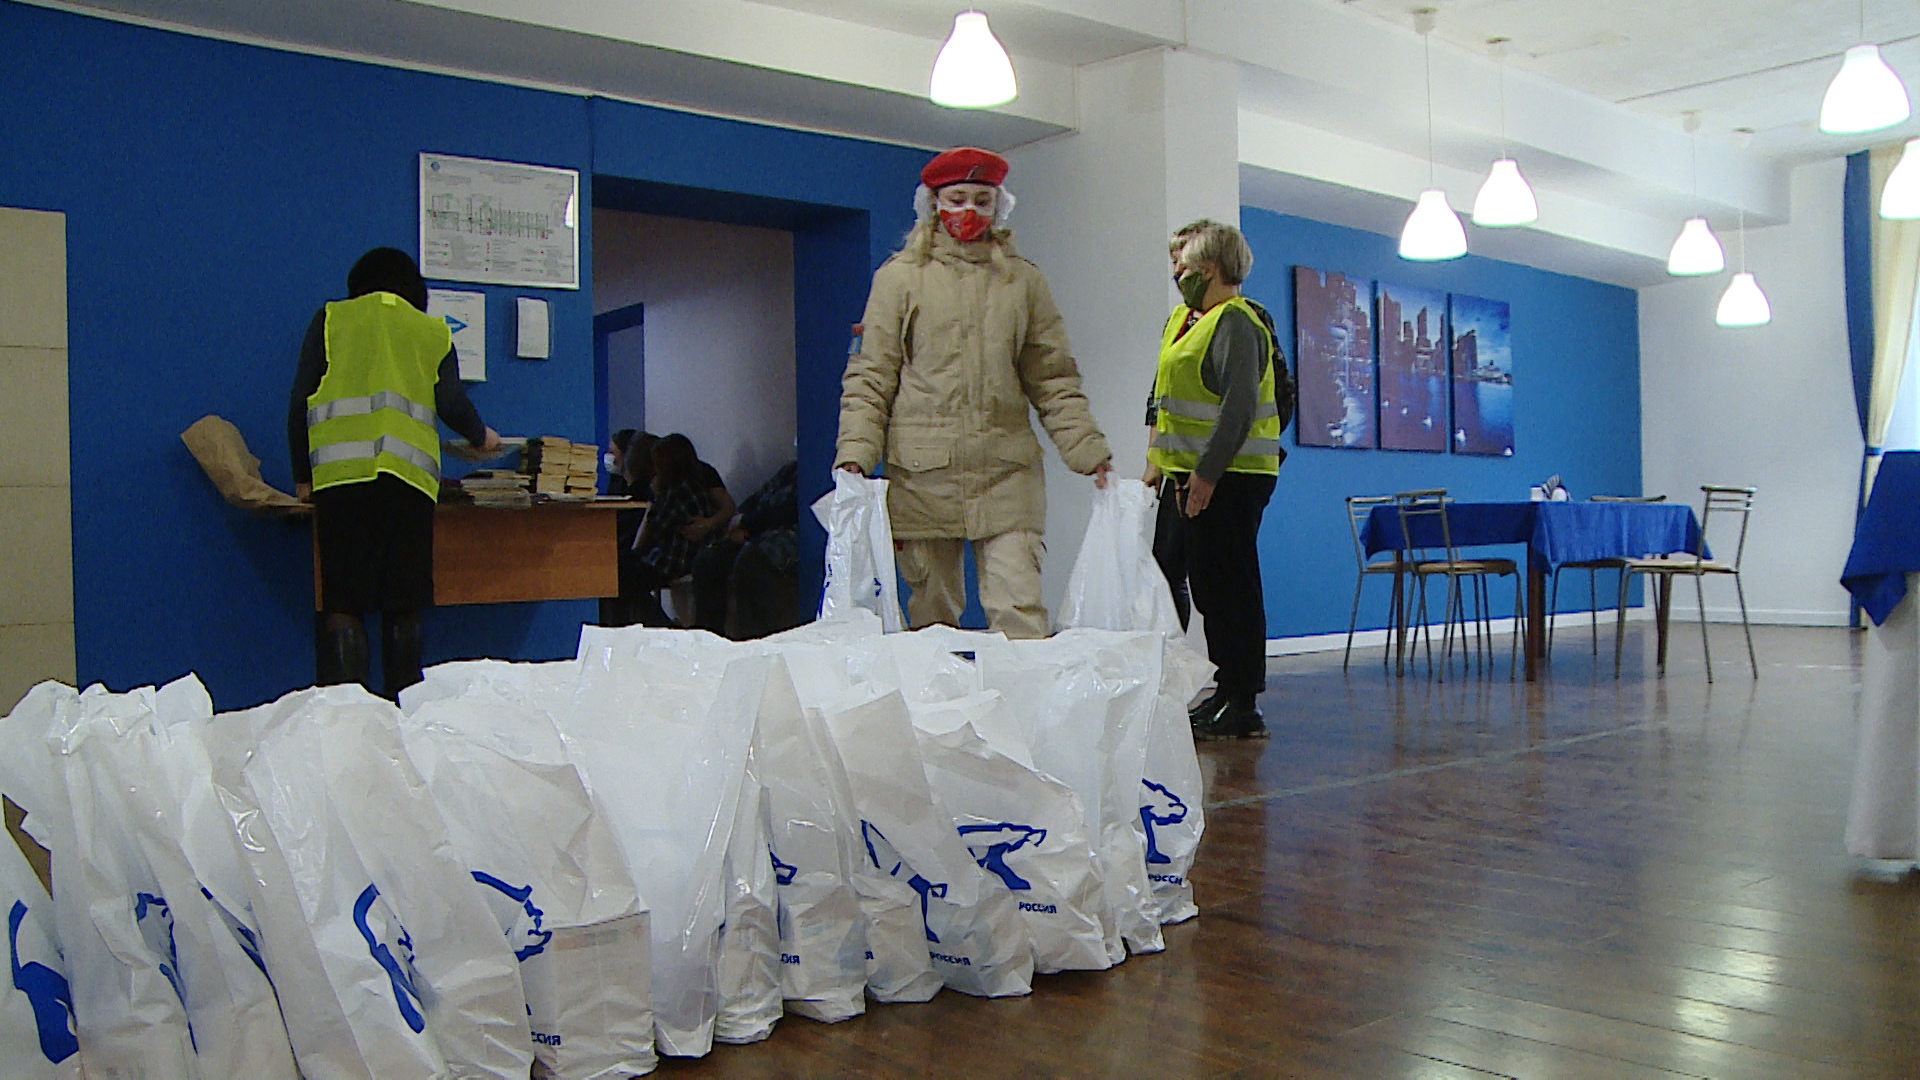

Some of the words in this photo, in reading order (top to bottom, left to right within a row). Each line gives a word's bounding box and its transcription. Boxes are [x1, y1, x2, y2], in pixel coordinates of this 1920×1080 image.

[1147, 873, 1183, 886] РОССИ
[1018, 901, 1057, 914] РОССИЯ
[780, 953, 800, 965] СИЯ
[530, 1031, 562, 1046] ССИЯ
